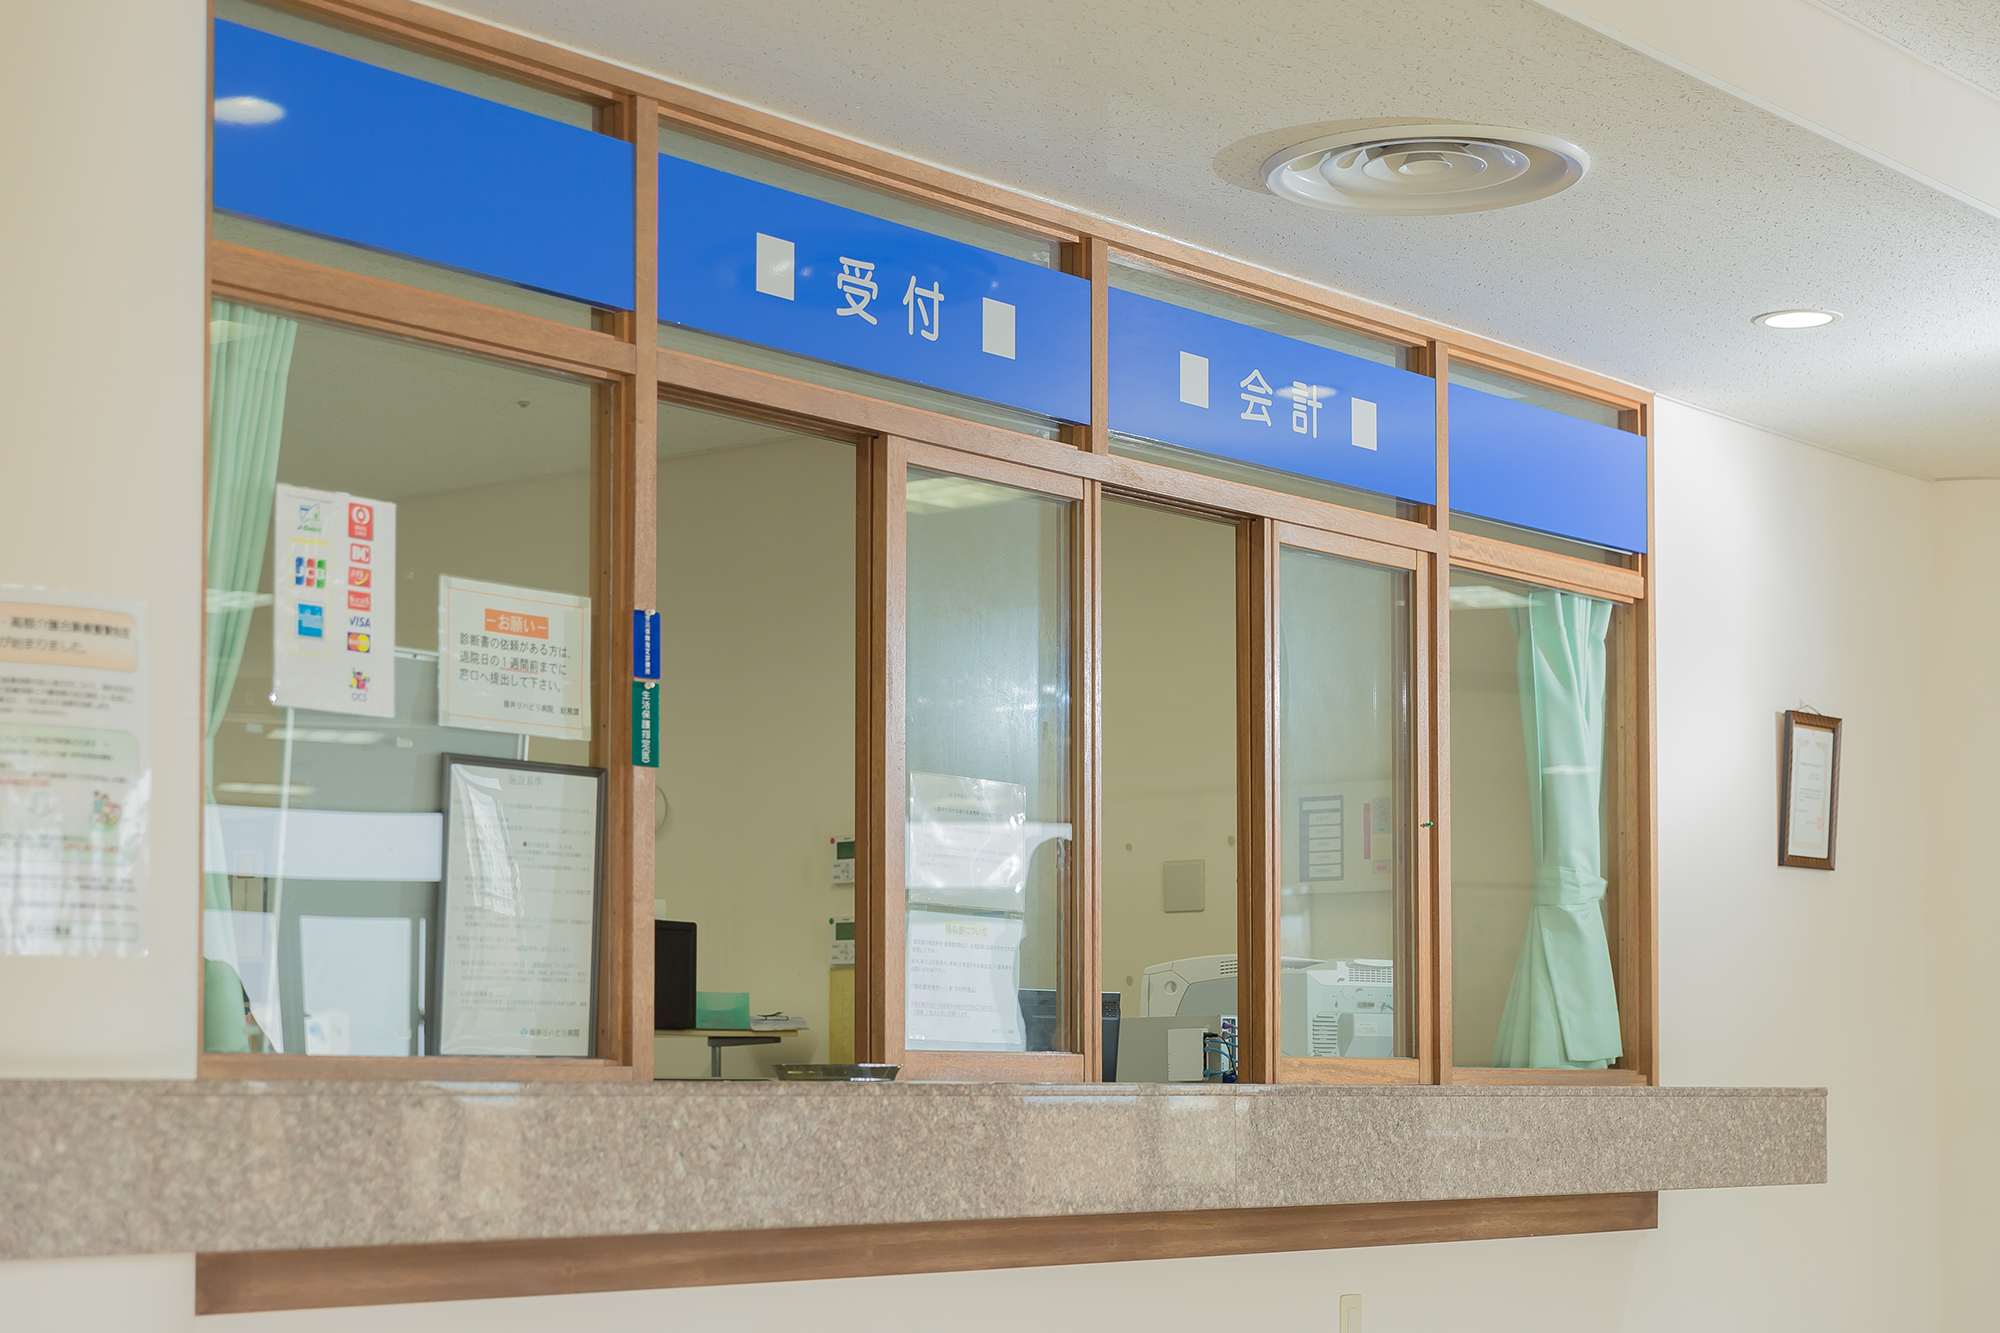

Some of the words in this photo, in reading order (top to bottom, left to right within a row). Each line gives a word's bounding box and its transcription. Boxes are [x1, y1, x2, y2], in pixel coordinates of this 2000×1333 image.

[836, 256, 945, 342] 受付
[1239, 368, 1324, 439] 会計
[352, 545, 370, 563] DC
[350, 615, 372, 628] VISA
[460, 632, 571, 659] 診断書の依頼がある方は、
[460, 668, 562, 693] 窓口へ提出して下さい。
[352, 692, 368, 702] OCS
[945, 924, 988, 937] 領収書について
